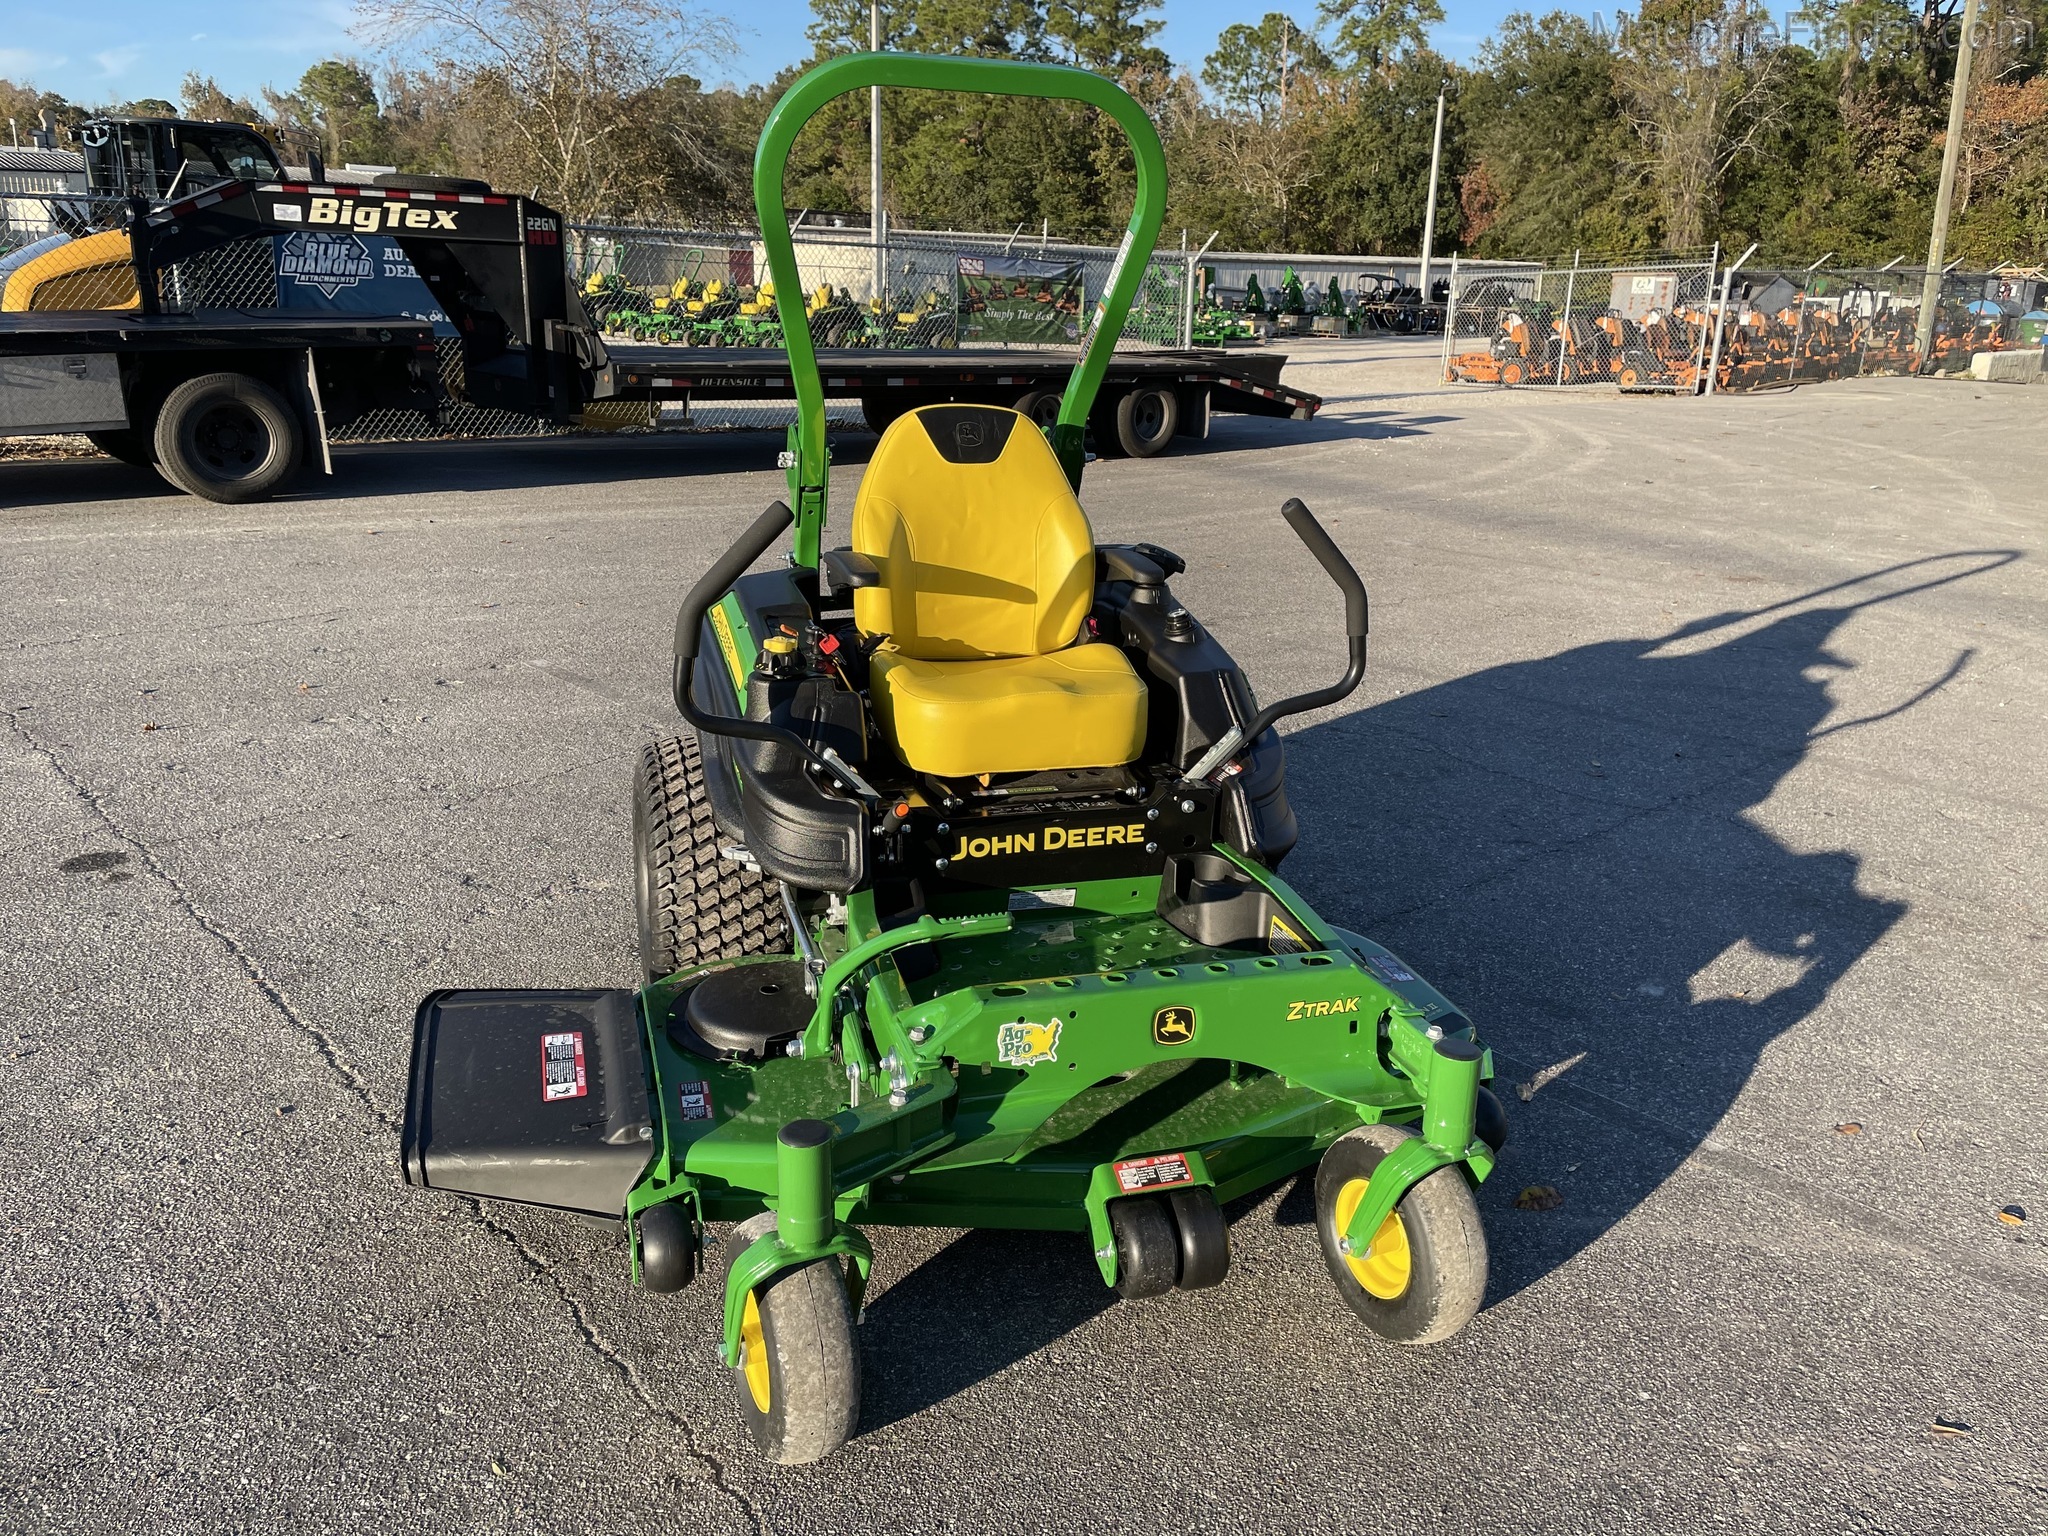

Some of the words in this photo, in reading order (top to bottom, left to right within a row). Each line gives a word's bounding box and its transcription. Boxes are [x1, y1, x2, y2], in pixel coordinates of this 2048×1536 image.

[528, 231, 557, 245] HD
[303, 241, 350, 260] BLUE
[383, 247, 411, 261] AU
[284, 256, 370, 276] DIAMOND
[960, 257, 984, 269] SCAG
[300, 273, 355, 284] ATTACHMENTS
[384, 264, 421, 279] DEA
[984, 307, 1014, 321] Simply
[1017, 309, 1033, 320] The
[1035, 310, 1054, 321] Best
[700, 378, 760, 386] HI-TENSILE
[951, 832, 1035, 861] JOHN
[1044, 823, 1145, 850] DEERE
[1286, 996, 1361, 1021] ZTRAK
[1002, 1027, 1031, 1043] Ag-
[1003, 1042, 1032, 1057] Pro
